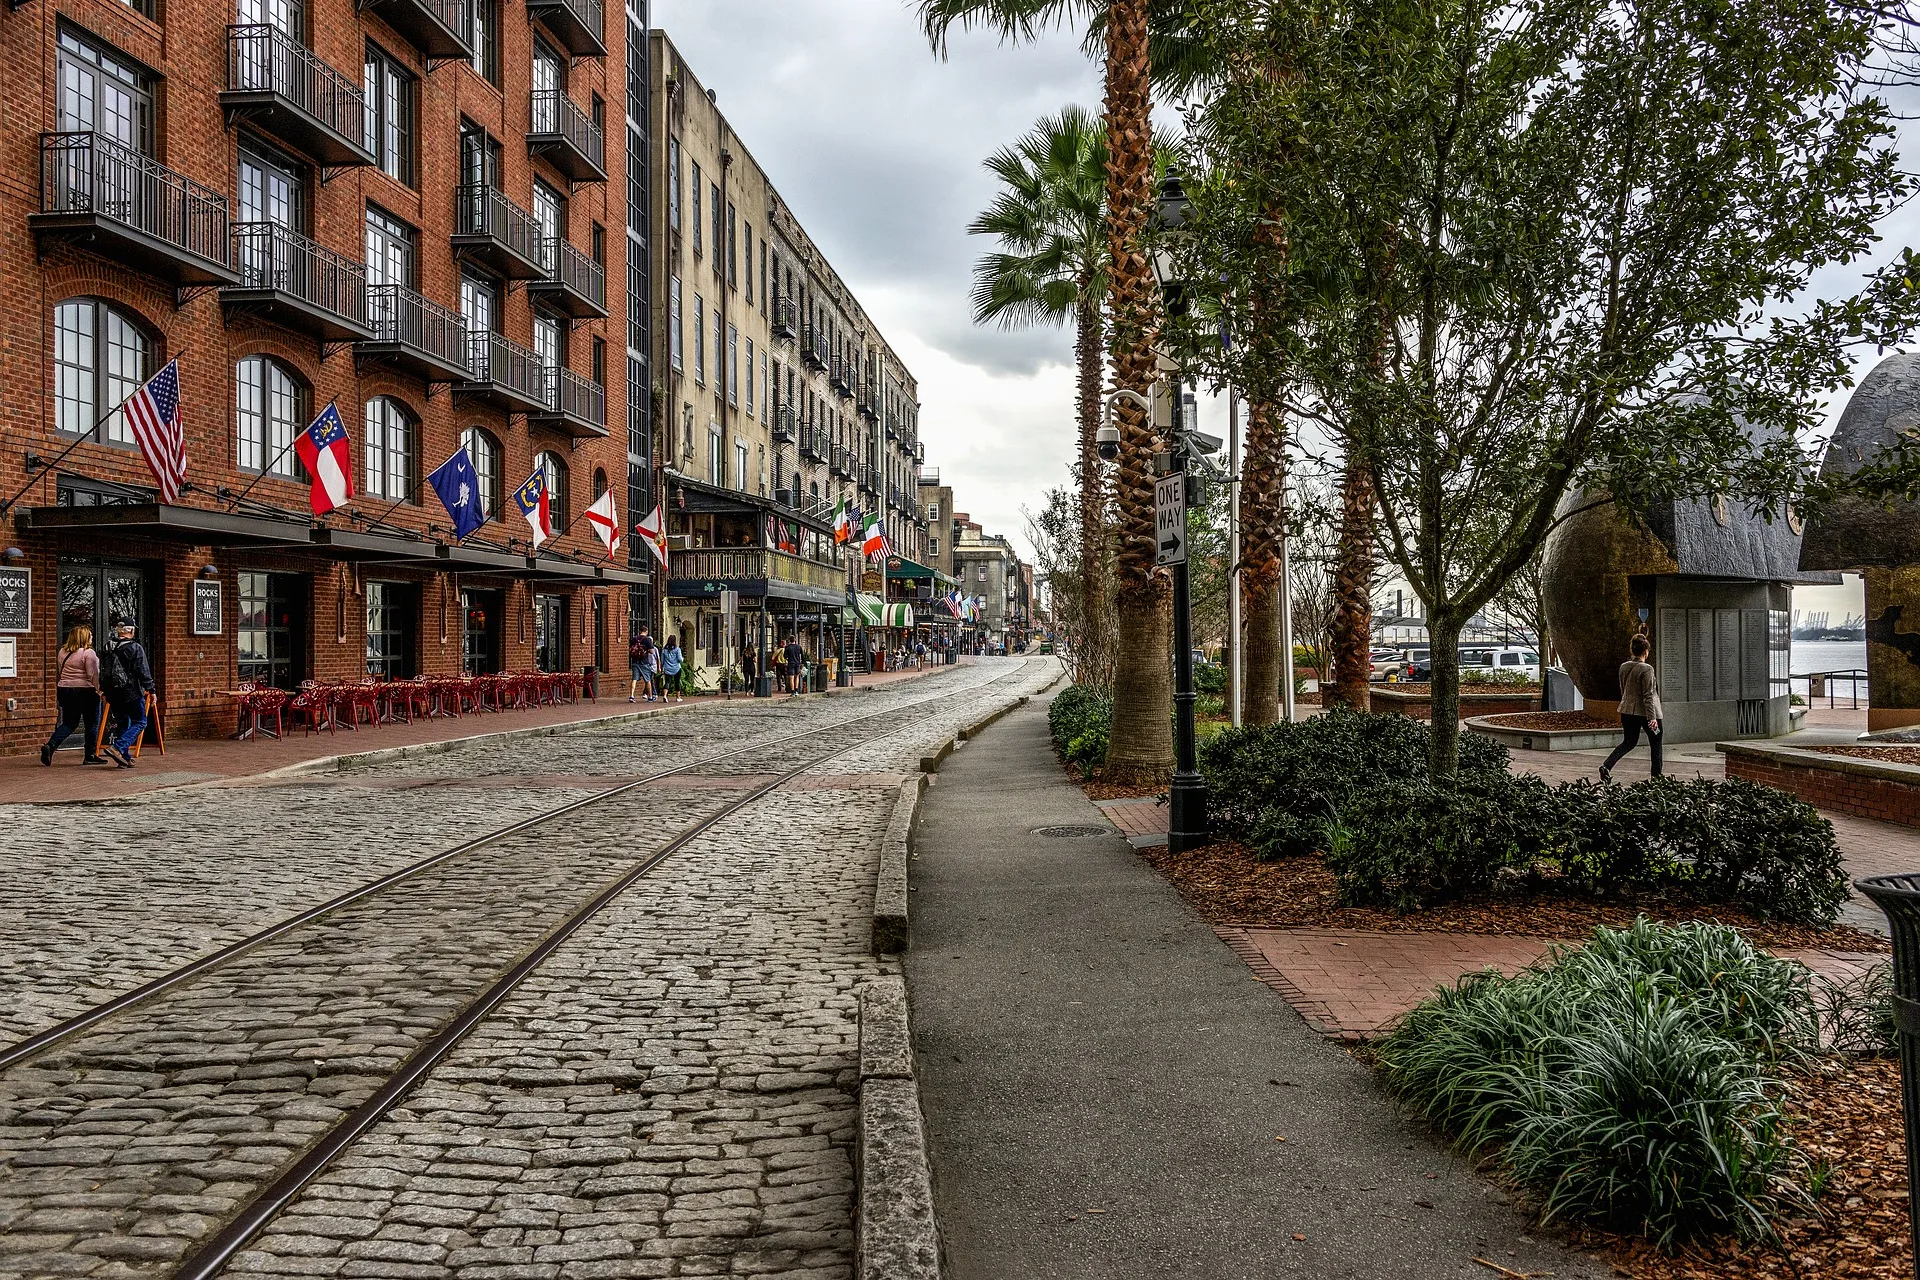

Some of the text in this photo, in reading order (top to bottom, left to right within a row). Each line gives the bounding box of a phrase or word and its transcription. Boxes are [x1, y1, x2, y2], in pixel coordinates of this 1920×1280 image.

[1158, 481, 1179, 506] ONE
[1159, 506, 1181, 531] WAY
[197, 588, 218, 597] ROCKS
